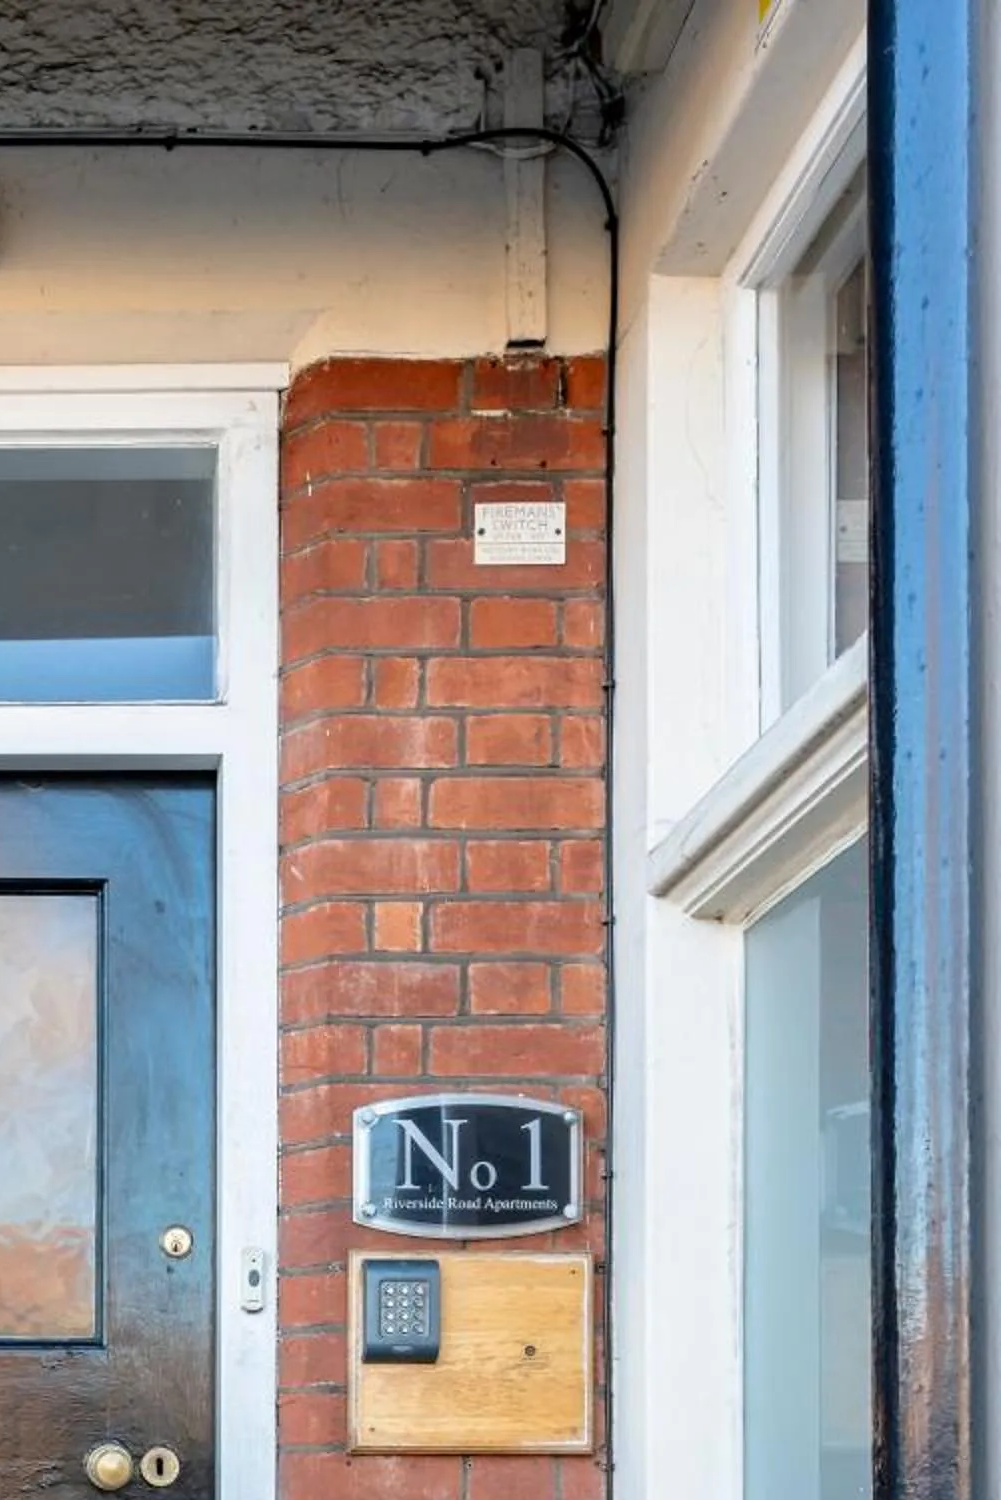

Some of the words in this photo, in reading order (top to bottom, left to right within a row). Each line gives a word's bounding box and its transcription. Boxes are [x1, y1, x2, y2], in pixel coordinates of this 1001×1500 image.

[520, 1117, 548, 1190] 1
[382, 1197, 445, 1210] Riverside
[447, 1197, 481, 1210] Road
[484, 1197, 559, 1213] Apartments
